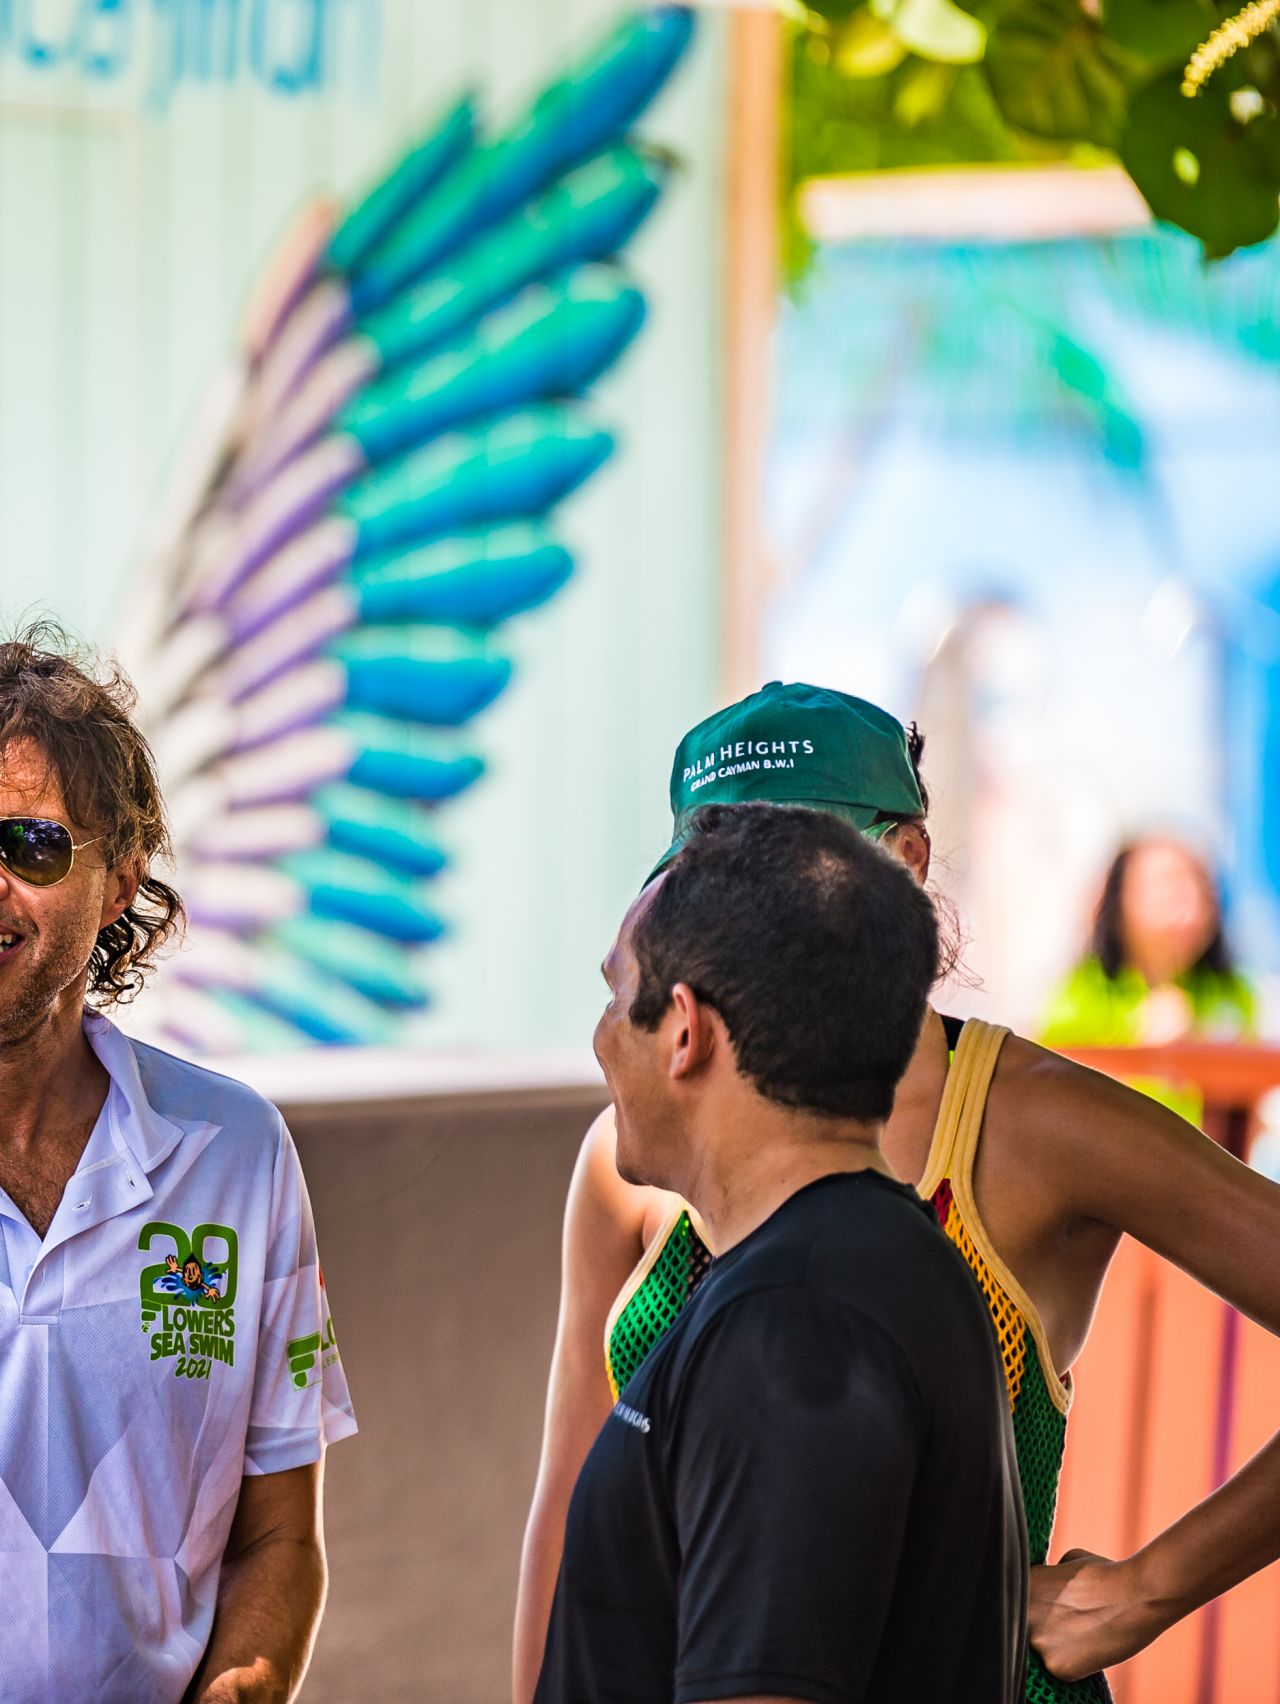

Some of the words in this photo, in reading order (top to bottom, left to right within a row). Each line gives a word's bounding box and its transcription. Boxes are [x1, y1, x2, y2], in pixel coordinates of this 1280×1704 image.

[683, 753, 715, 783] PALM
[720, 739, 814, 761] HEIGHTS
[690, 771, 717, 792] GRAND
[718, 760, 760, 778] CAYMAN
[763, 758, 795, 769] B.W.I
[150, 1332, 187, 1361] SEA
[189, 1333, 235, 1368] SWIM
[175, 1357, 213, 1381] 2021
